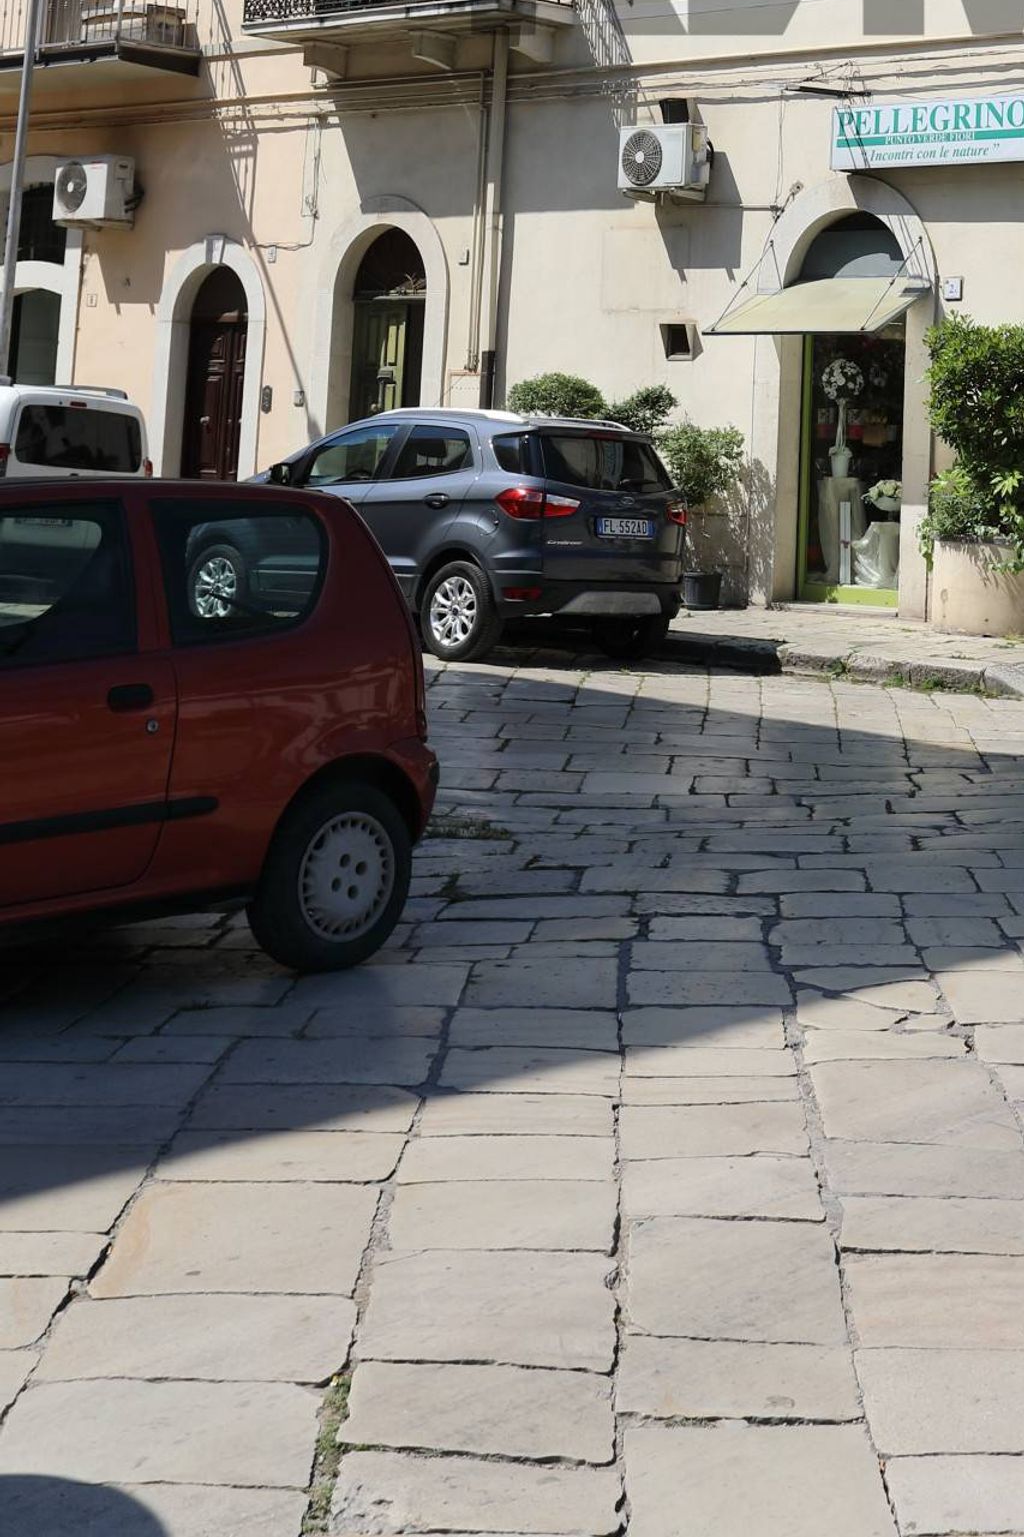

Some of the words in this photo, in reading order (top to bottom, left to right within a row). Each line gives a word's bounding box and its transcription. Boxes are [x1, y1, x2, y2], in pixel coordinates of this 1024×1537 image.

[869, 147, 914, 162] Incontri
[917, 149, 936, 160] con
[939, 146, 950, 158] le
